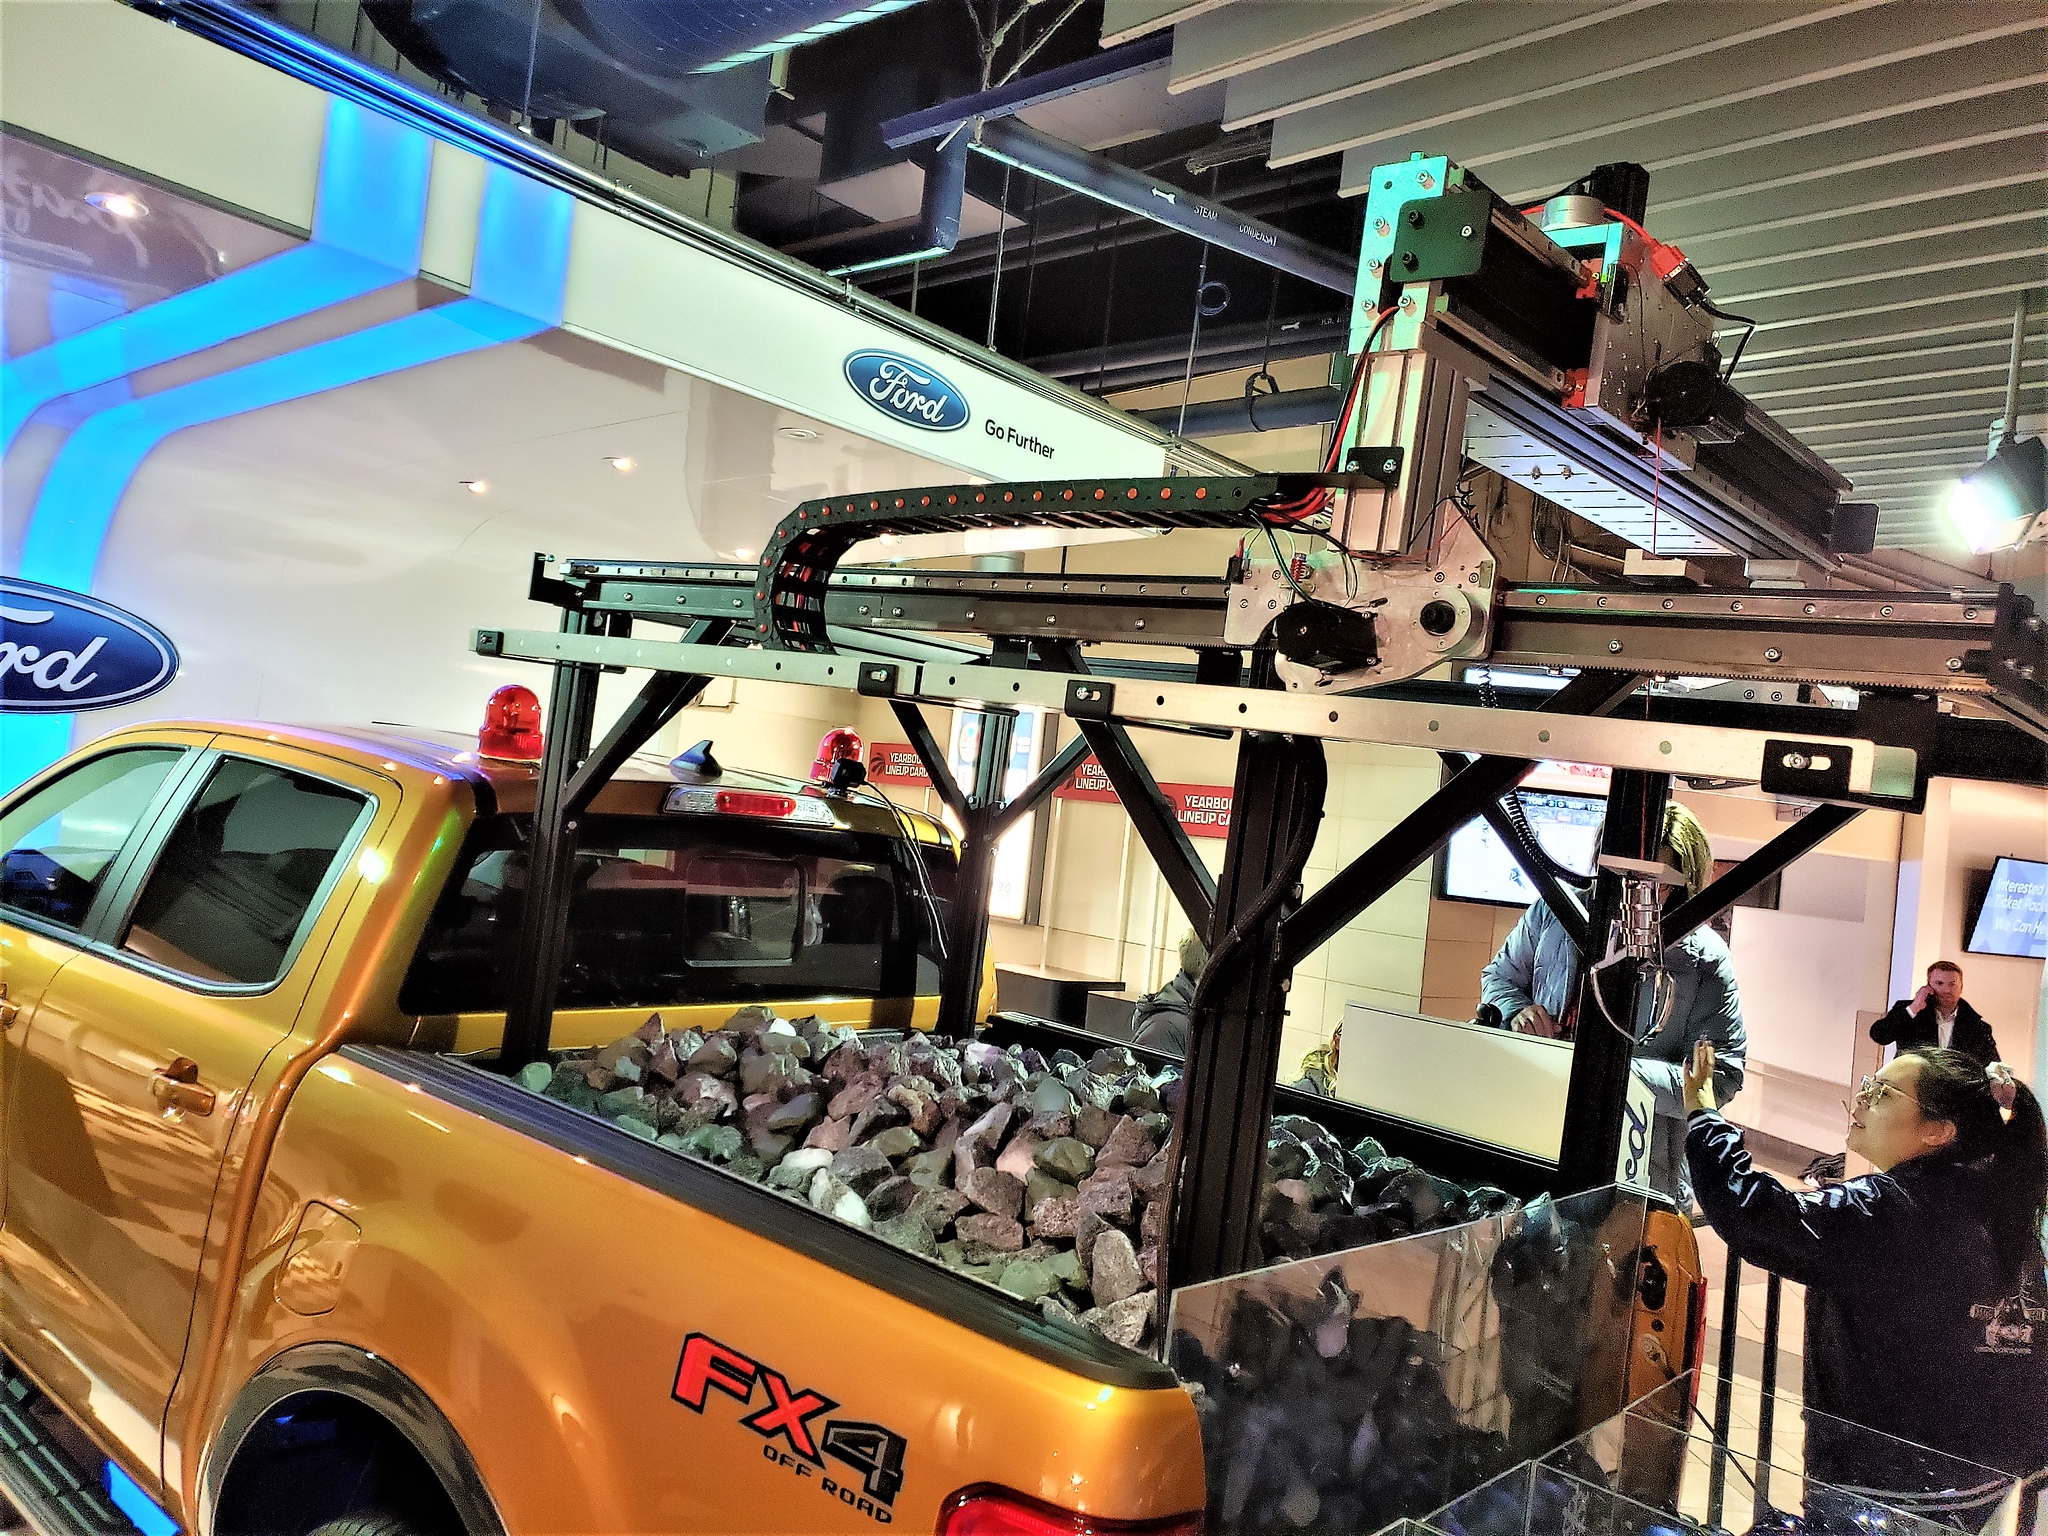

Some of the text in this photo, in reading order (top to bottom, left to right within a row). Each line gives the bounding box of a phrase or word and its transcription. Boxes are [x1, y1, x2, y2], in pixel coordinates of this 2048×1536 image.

[1194, 205, 1218, 220] STEAM
[869, 361, 948, 423] Ford
[985, 418, 1055, 459] Go Further
[885, 765, 909, 776] LINEUP
[1081, 763, 1107, 777] YEAR
[1075, 777, 1106, 791] LINEUP
[1178, 810, 1217, 824] LINEUP
[1995, 878, 2044, 896] Interested
[1994, 893, 2022, 910] Ticket
[1995, 917, 2048, 937] We Can He
[671, 1332, 907, 1506] FX4
[763, 1444, 892, 1524] OFF ROAD
